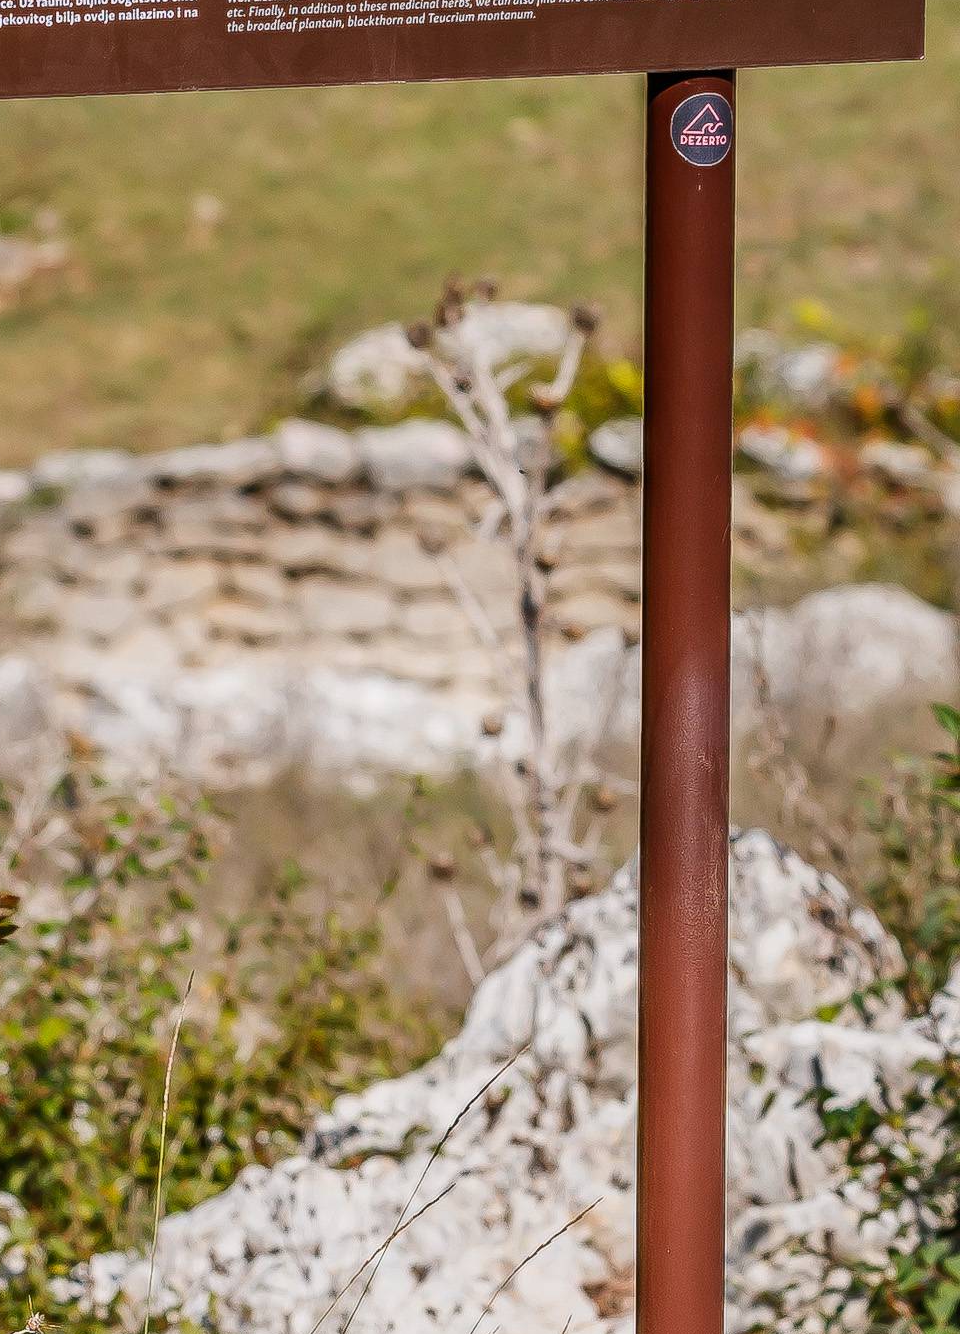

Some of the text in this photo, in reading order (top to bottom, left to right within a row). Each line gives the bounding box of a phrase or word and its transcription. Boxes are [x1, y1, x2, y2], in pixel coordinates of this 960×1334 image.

[226, 10, 535, 32] the broadleaf plantain, blackthorn and Teucrium montanum.
[680, 135, 727, 146] DEZERTO
